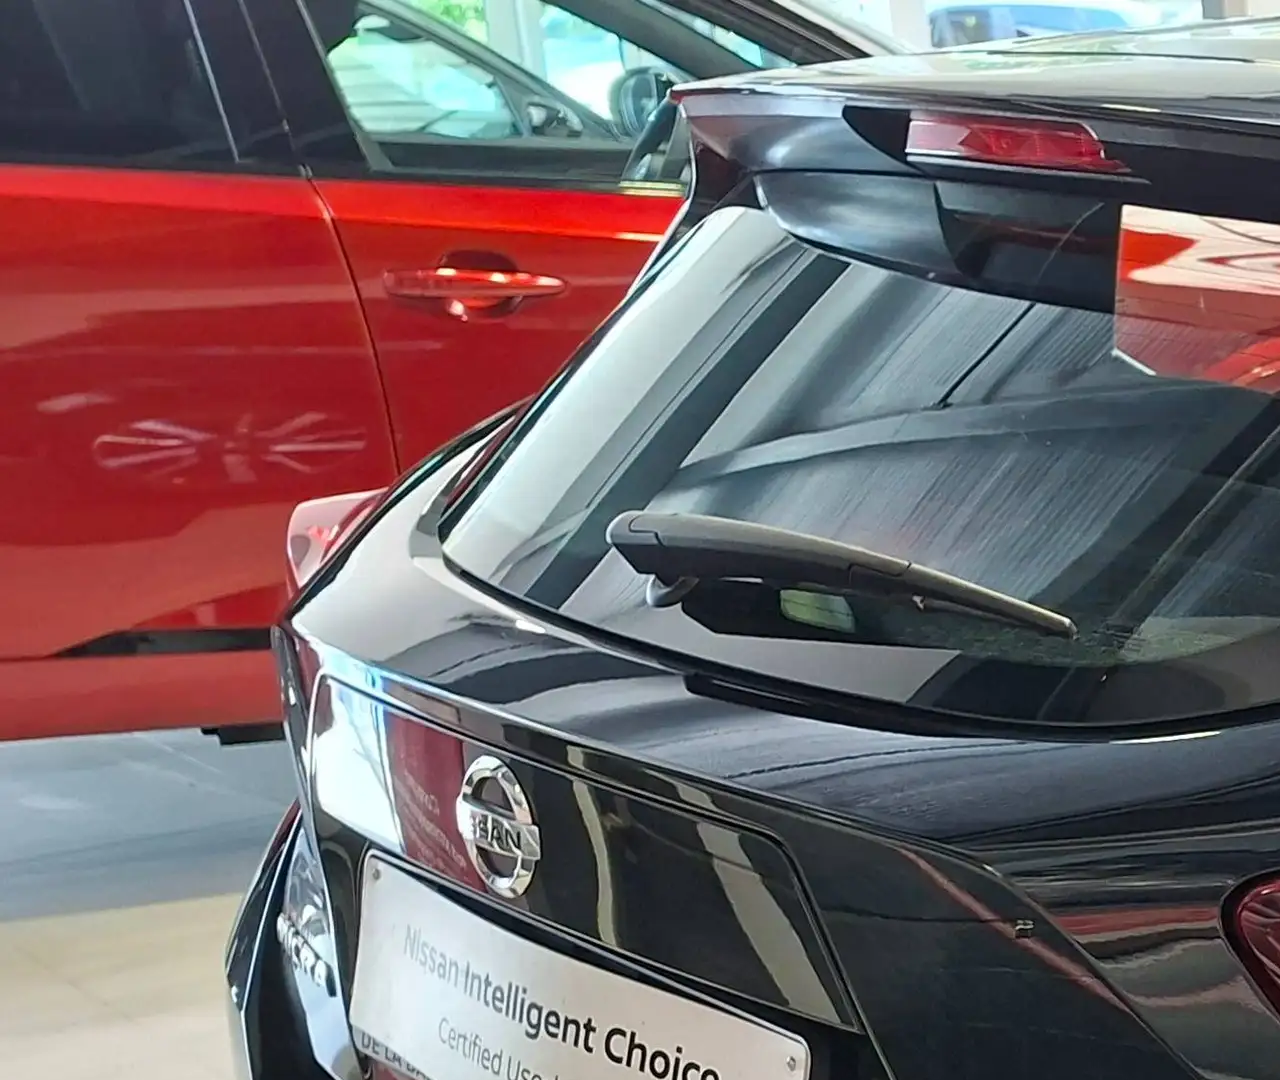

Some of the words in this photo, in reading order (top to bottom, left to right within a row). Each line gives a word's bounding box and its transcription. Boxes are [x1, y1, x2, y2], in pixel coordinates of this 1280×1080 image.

[463, 807, 522, 850] SAN
[403, 923, 459, 988] Nissan
[463, 960, 597, 1054] Intelligent
[437, 1017, 503, 1077] Certified
